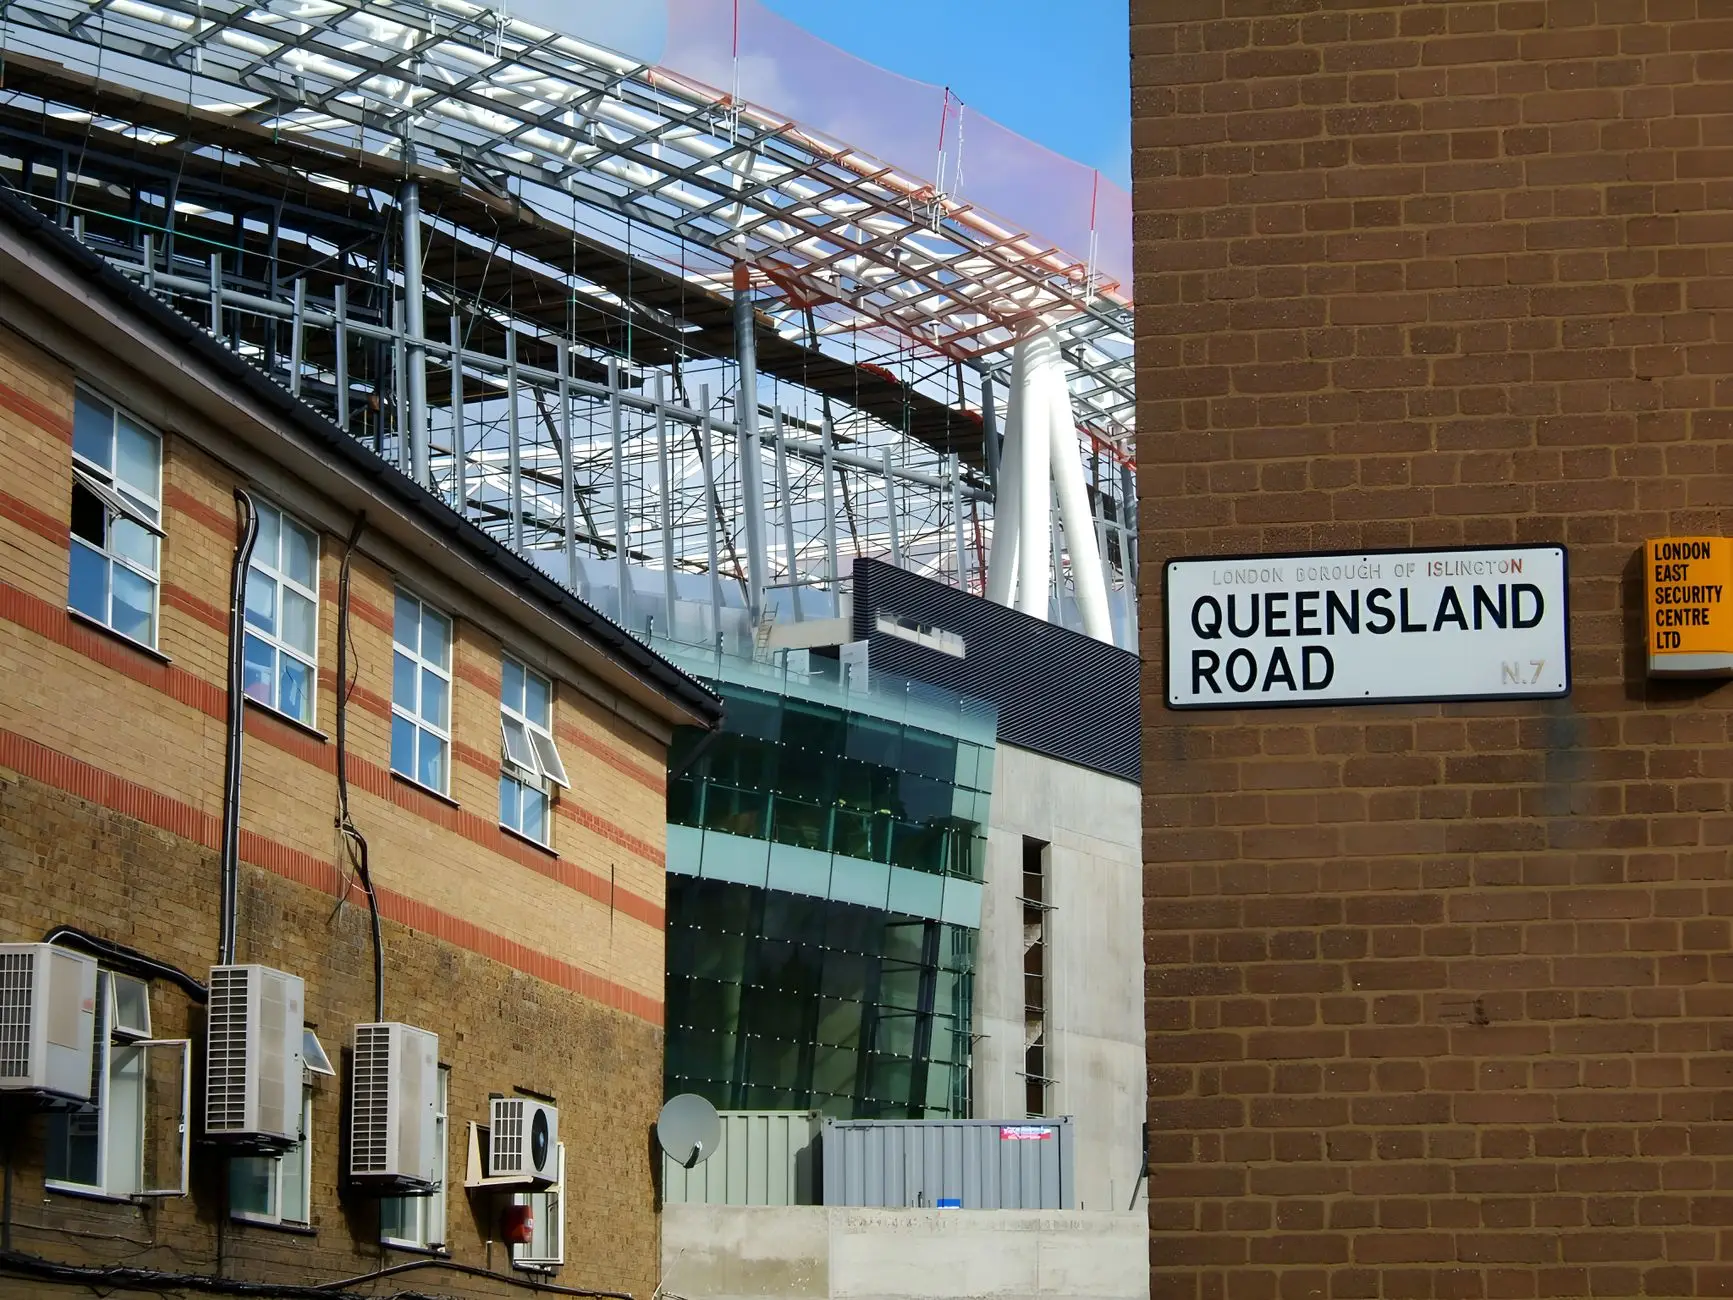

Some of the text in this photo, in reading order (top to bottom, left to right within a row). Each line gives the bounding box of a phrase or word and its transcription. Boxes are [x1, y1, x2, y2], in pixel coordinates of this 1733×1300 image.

[1655, 542, 1710, 560] LONDON
[1213, 568, 1283, 585] LONDON
[1428, 558, 1523, 577] ISLINGTON
[1655, 564, 1689, 582] EAST
[1655, 585, 1723, 604] SECURITY
[1192, 583, 1545, 639] QUEENSLAND
[1656, 608, 1709, 626] CENTRE
[1656, 631, 1681, 649] LTD
[1192, 645, 1335, 694] ROAD
[1502, 660, 1546, 684] N.7
